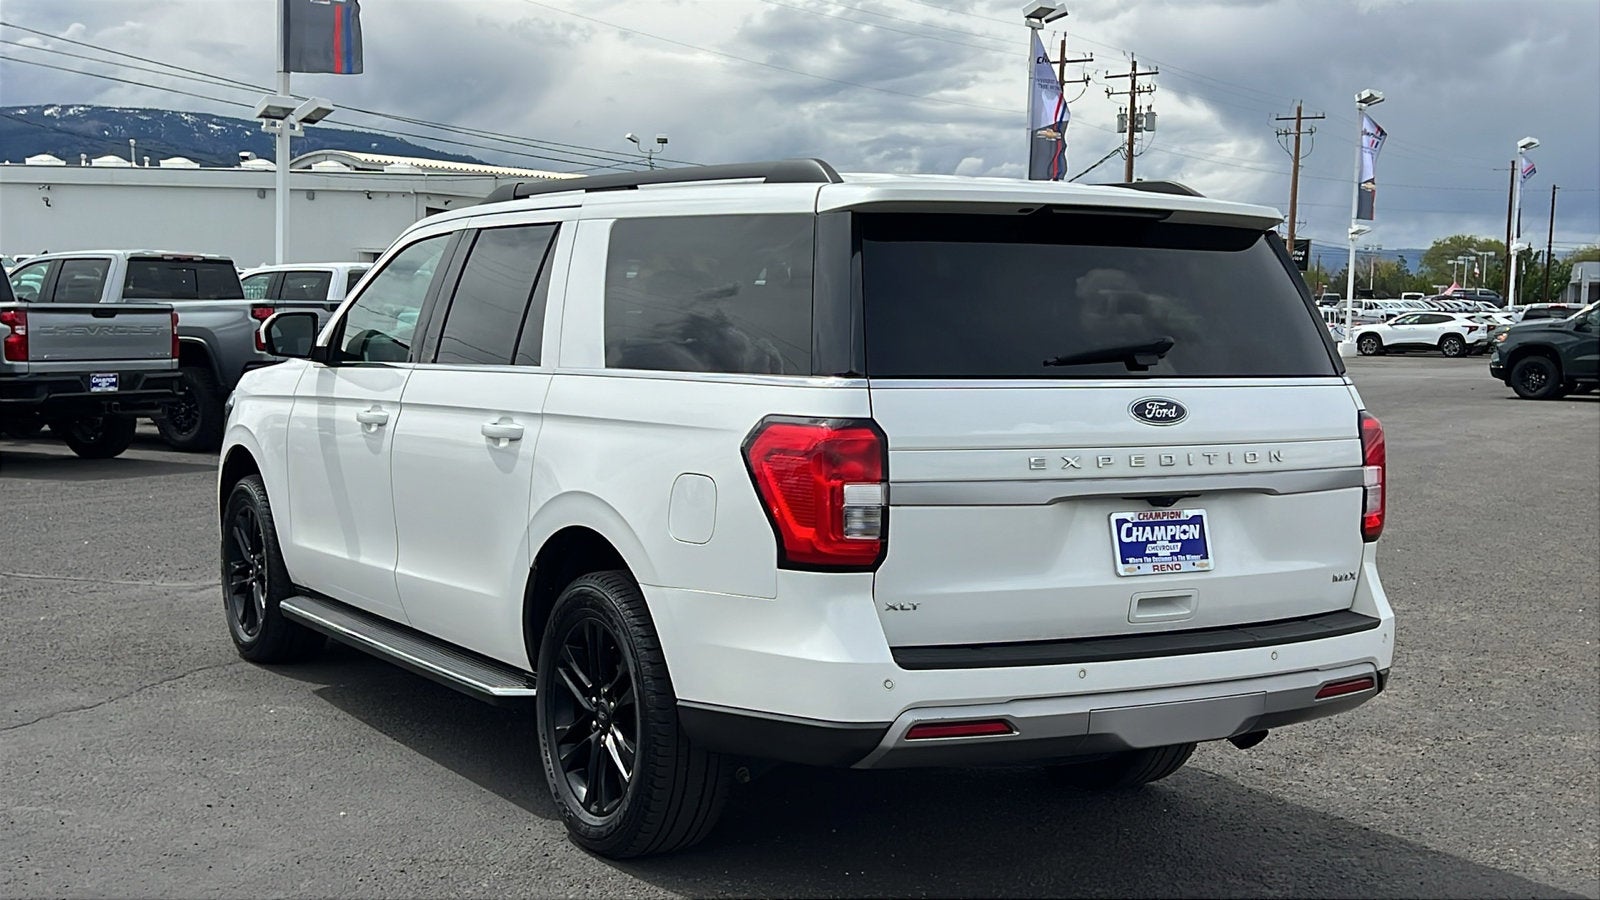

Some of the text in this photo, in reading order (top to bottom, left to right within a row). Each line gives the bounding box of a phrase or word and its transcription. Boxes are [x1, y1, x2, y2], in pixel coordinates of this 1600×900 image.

[1144, 401, 1178, 419] Ford
[1028, 450, 1284, 470] EXPEDITION
[1138, 511, 1181, 520] CHAMPION
[1120, 522, 1200, 543] CHAMPION
[1147, 543, 1179, 552] CHEVROLET
[1152, 563, 1181, 572] RENO
[885, 601, 921, 611] XLT
